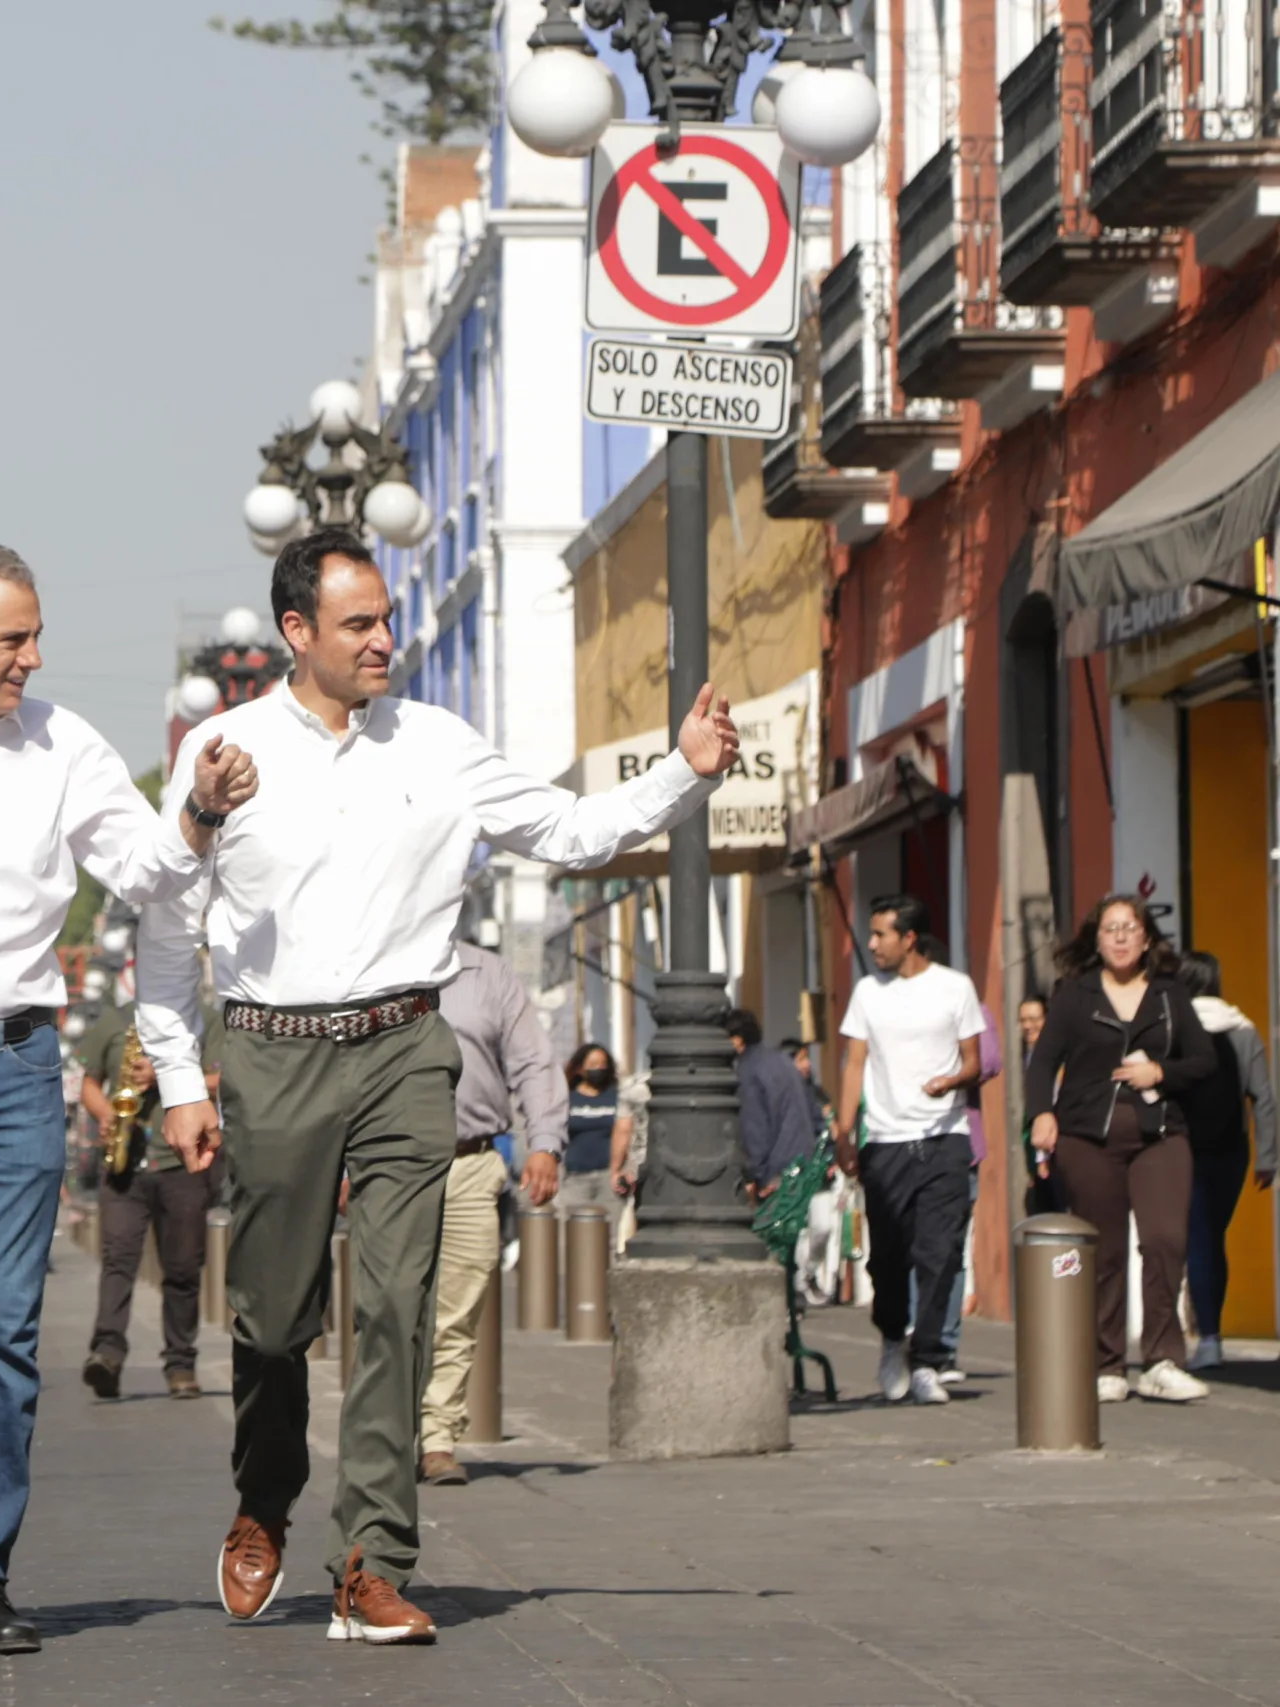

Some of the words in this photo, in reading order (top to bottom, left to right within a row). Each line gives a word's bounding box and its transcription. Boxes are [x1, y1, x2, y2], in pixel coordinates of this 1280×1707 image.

[657, 181, 728, 276] E
[597, 347, 658, 377] SOLO
[673, 354, 781, 388] ASCENSO
[613, 387, 625, 412] Y
[640, 390, 761, 424] DESCENSO
[618, 751, 776, 781] BAS
